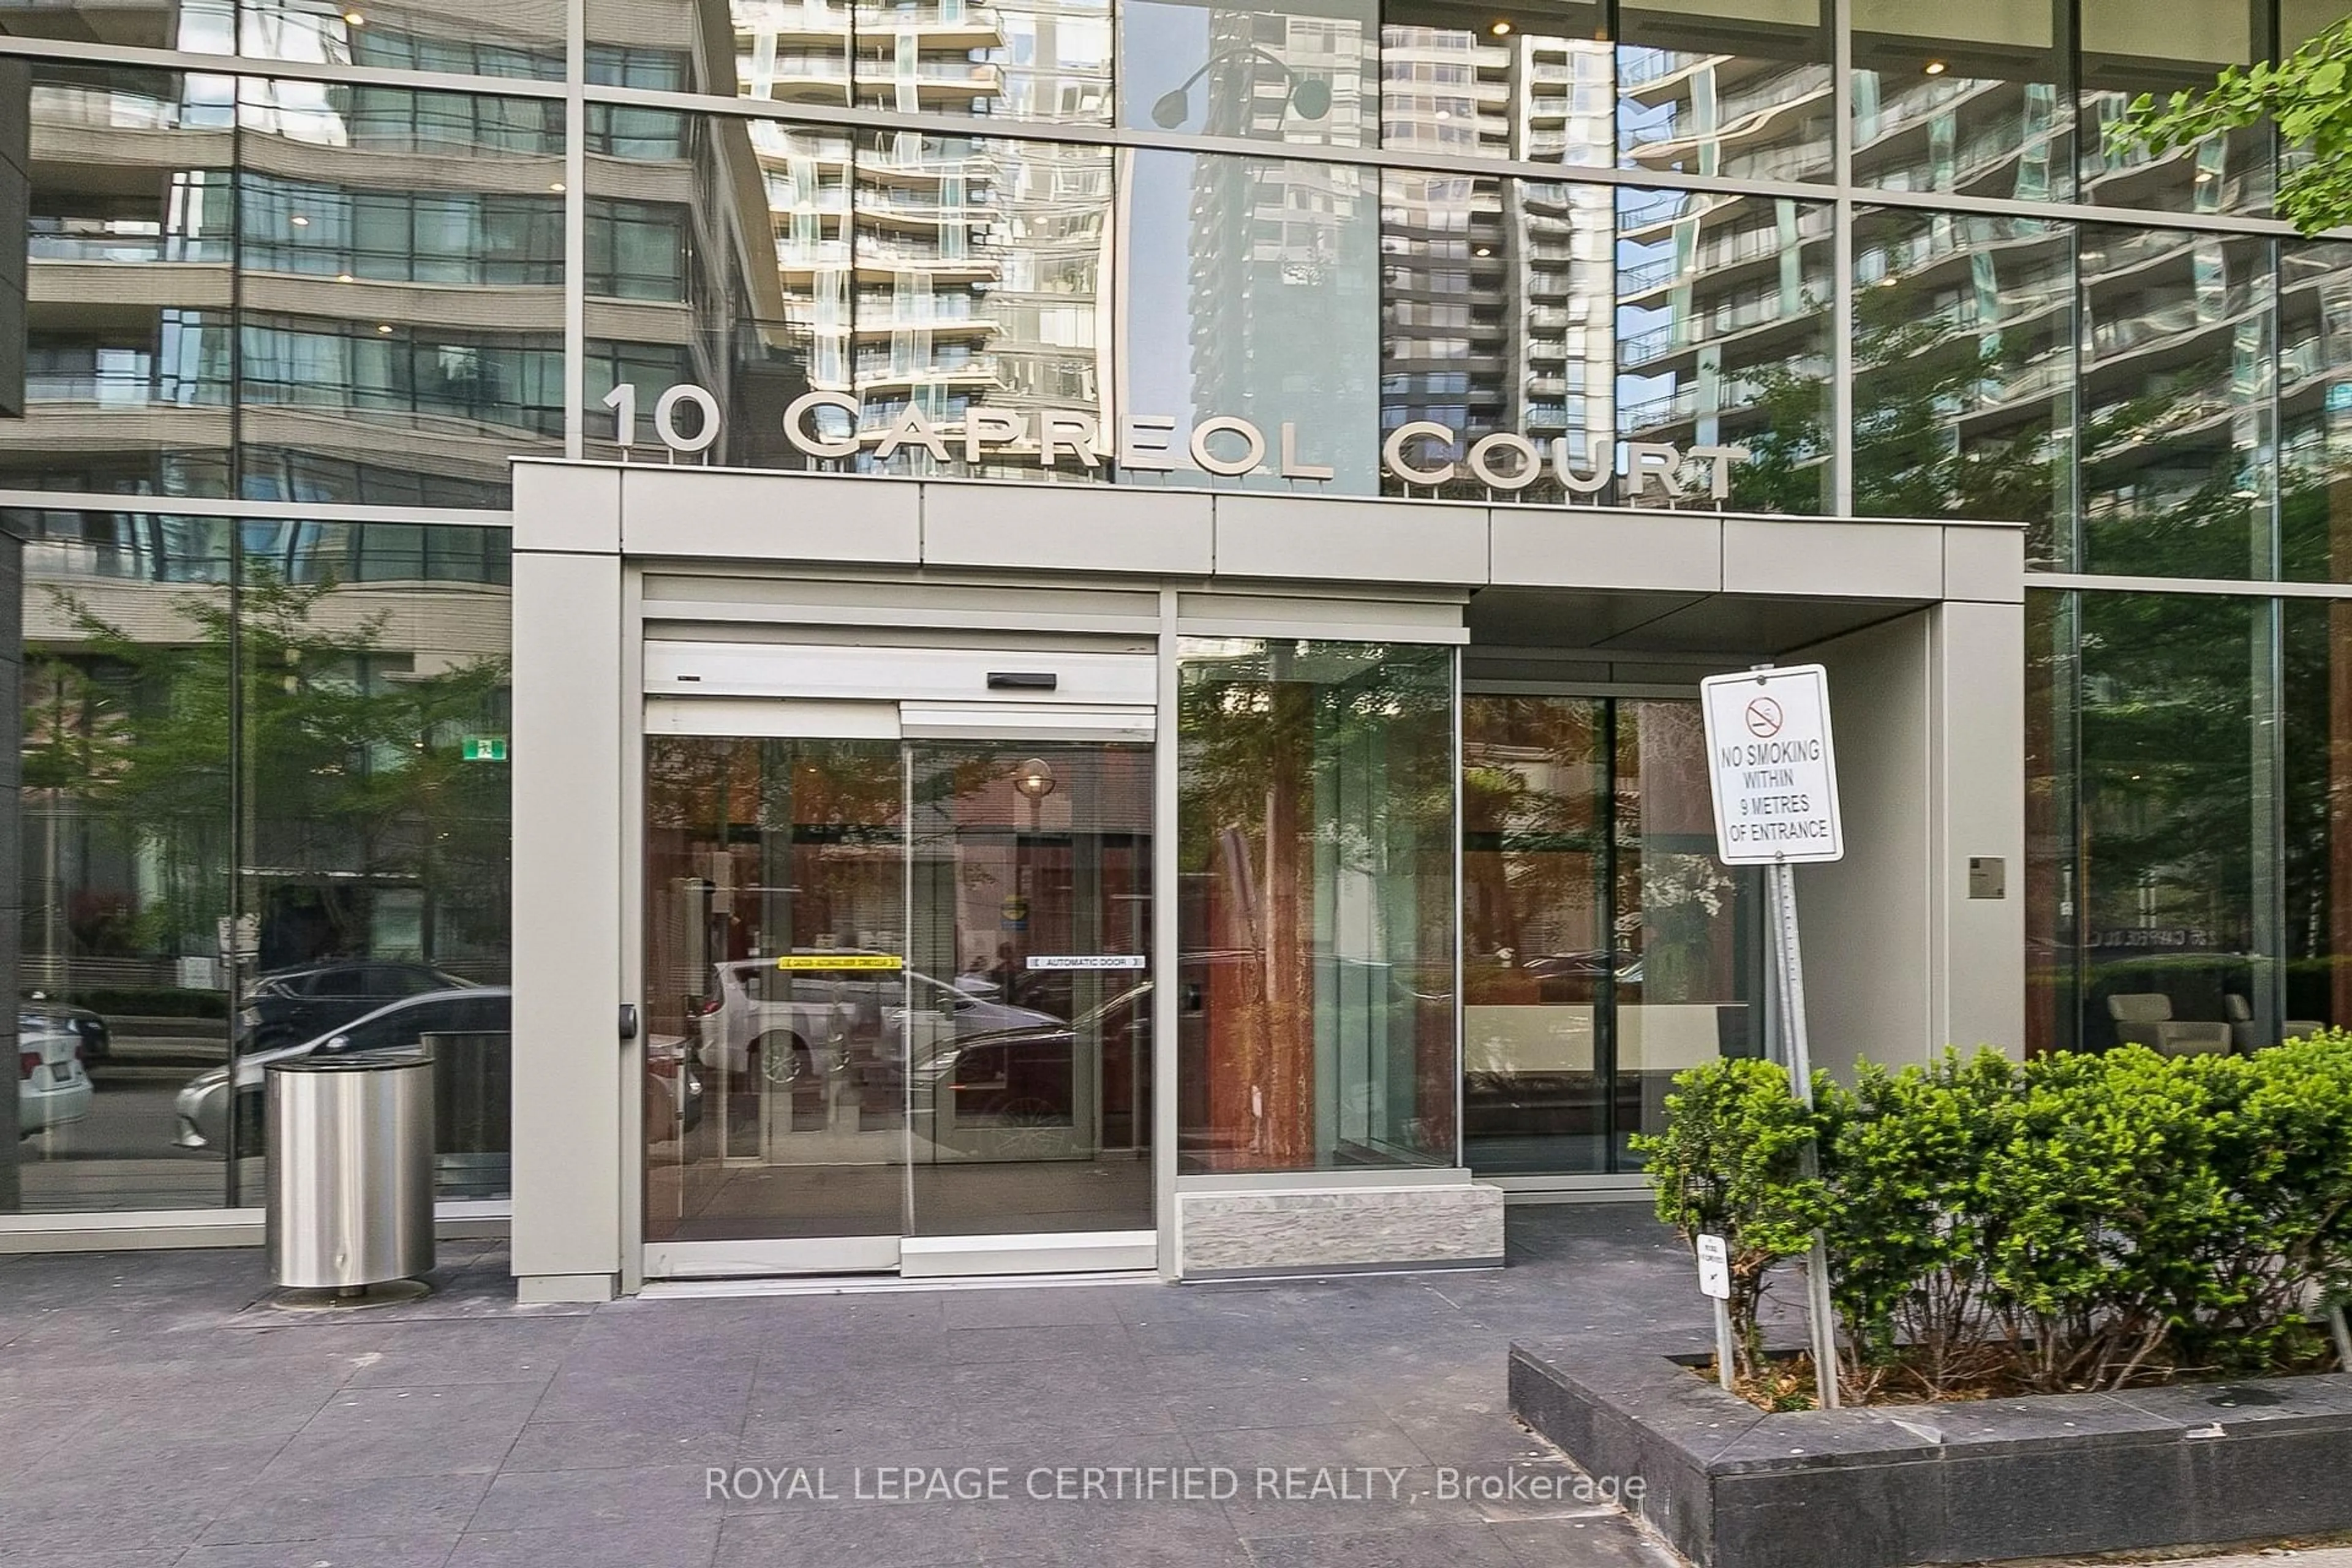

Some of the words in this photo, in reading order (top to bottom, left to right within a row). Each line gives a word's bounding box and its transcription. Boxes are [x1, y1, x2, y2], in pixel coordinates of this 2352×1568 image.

[602, 383, 720, 452] 10
[783, 391, 1335, 480] CAPREOL
[1382, 420, 1751, 499] COURT
[1722, 745, 1743, 768] NO
[1747, 739, 1820, 766] SMOKING
[1743, 768, 1795, 790] WITHIN
[1740, 798, 1748, 816] 9
[1752, 794, 1810, 815] METRES
[1730, 824, 1747, 842] OF
[1752, 819, 1829, 842] ENTRANCE
